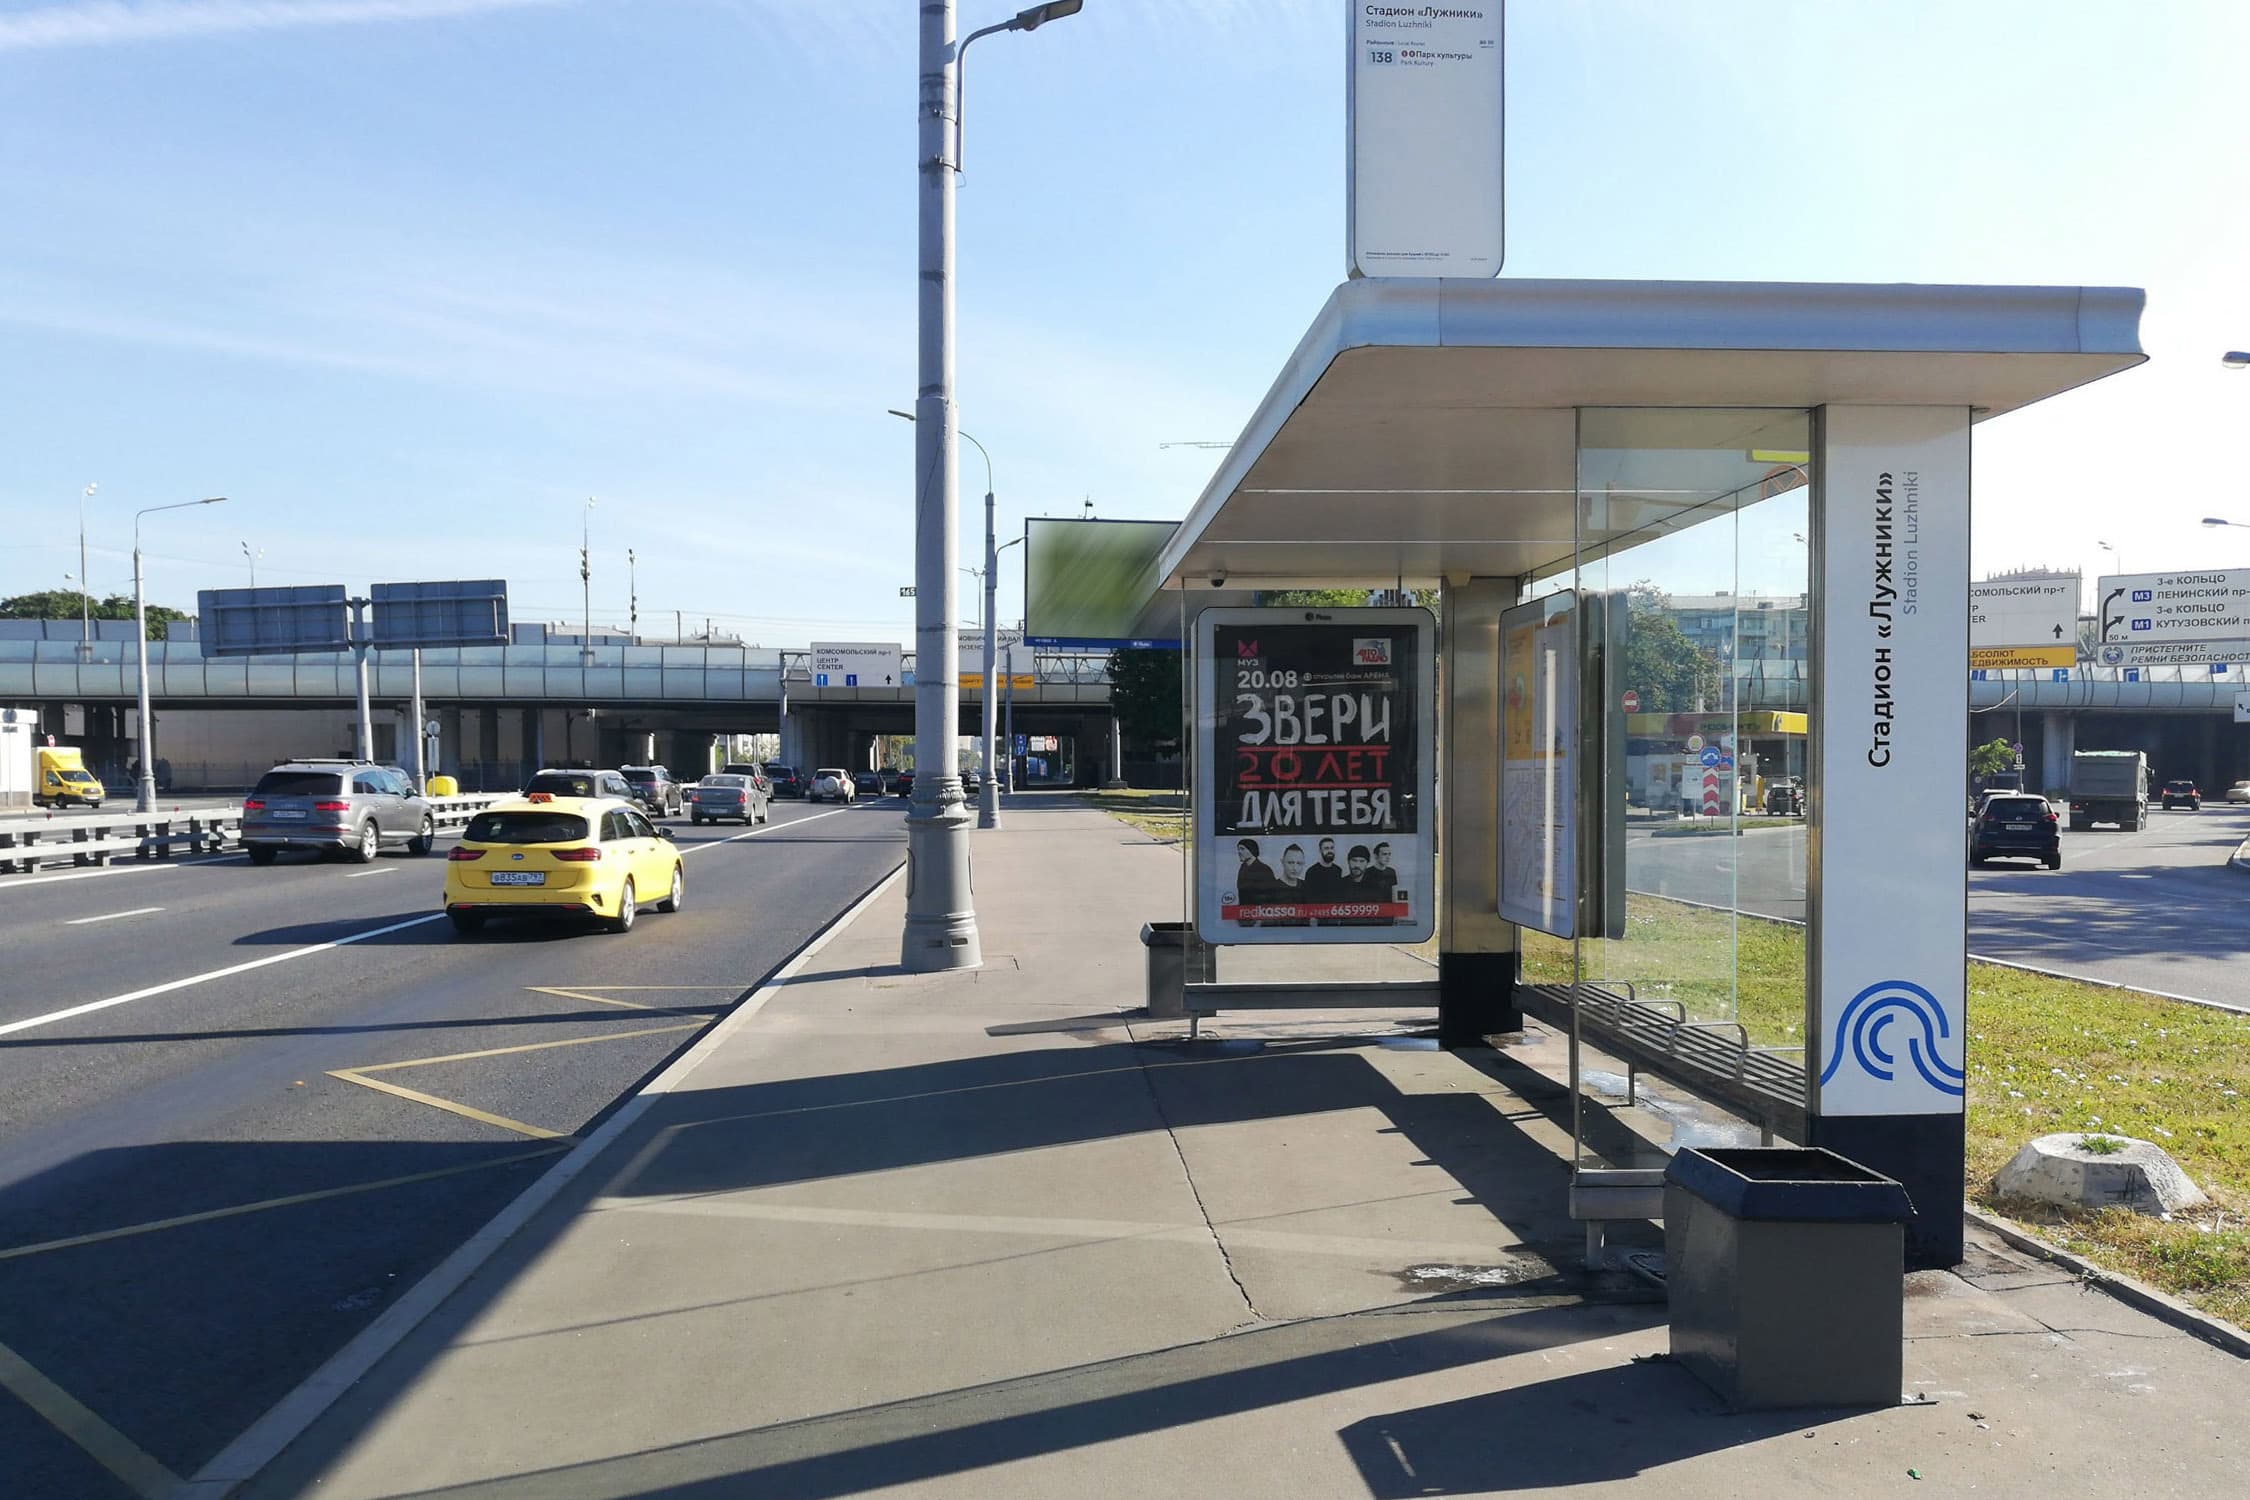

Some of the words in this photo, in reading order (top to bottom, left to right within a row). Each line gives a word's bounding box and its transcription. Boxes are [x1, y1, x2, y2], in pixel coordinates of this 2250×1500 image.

[1366, 5, 1415, 17] Стадион
[1417, 7, 1483, 19] «Лужники»
[1366, 20, 1396, 28] Stadion
[1398, 20, 1432, 29] Luzhniki
[1371, 52, 1393, 63] 138
[1416, 51, 1435, 59] Парк
[1437, 52, 1472, 60] культуры
[1903, 471, 1918, 544] Luzhniki
[1870, 471, 1897, 638] «Лужники»
[1903, 549, 1918, 615] Stadion
[2176, 574, 2226, 585] КОЛЬЦО
[1970, 585, 2041, 597] ОМОЛЬСКИЙ
[2043, 587, 2065, 595] пр-т
[2157, 587, 2229, 600] ЛЕНИНСКИЙ
[2176, 603, 2225, 613] КОЛЬЦО
[2156, 616, 2239, 629] КУТУЗОВСКИЙ
[816, 647, 877, 655] КОМСОМОЛЬСКИЙ
[1970, 650, 2016, 658] БСОЛЮТ
[2131, 644, 2207, 654] ПРИСТЕГНИТЕ
[1971, 658, 2048, 667] ЕДВИЖИМОСТЬ
[2131, 655, 2168, 663] РЕМНИ
[2169, 653, 2250, 662] БЕЗОПАСНОСТ
[1237, 670, 1298, 689] 20.08
[1868, 648, 1894, 768] Стадион
[1236, 693, 1390, 746] ЗВЕРИ
[1238, 750, 1301, 782] 20
[1315, 750, 1390, 782] ЛЕТ
[1236, 789, 1301, 829] ДЛЯ
[1307, 789, 1393, 826] ТЕБЯ
[1330, 904, 1380, 916] 6659999
